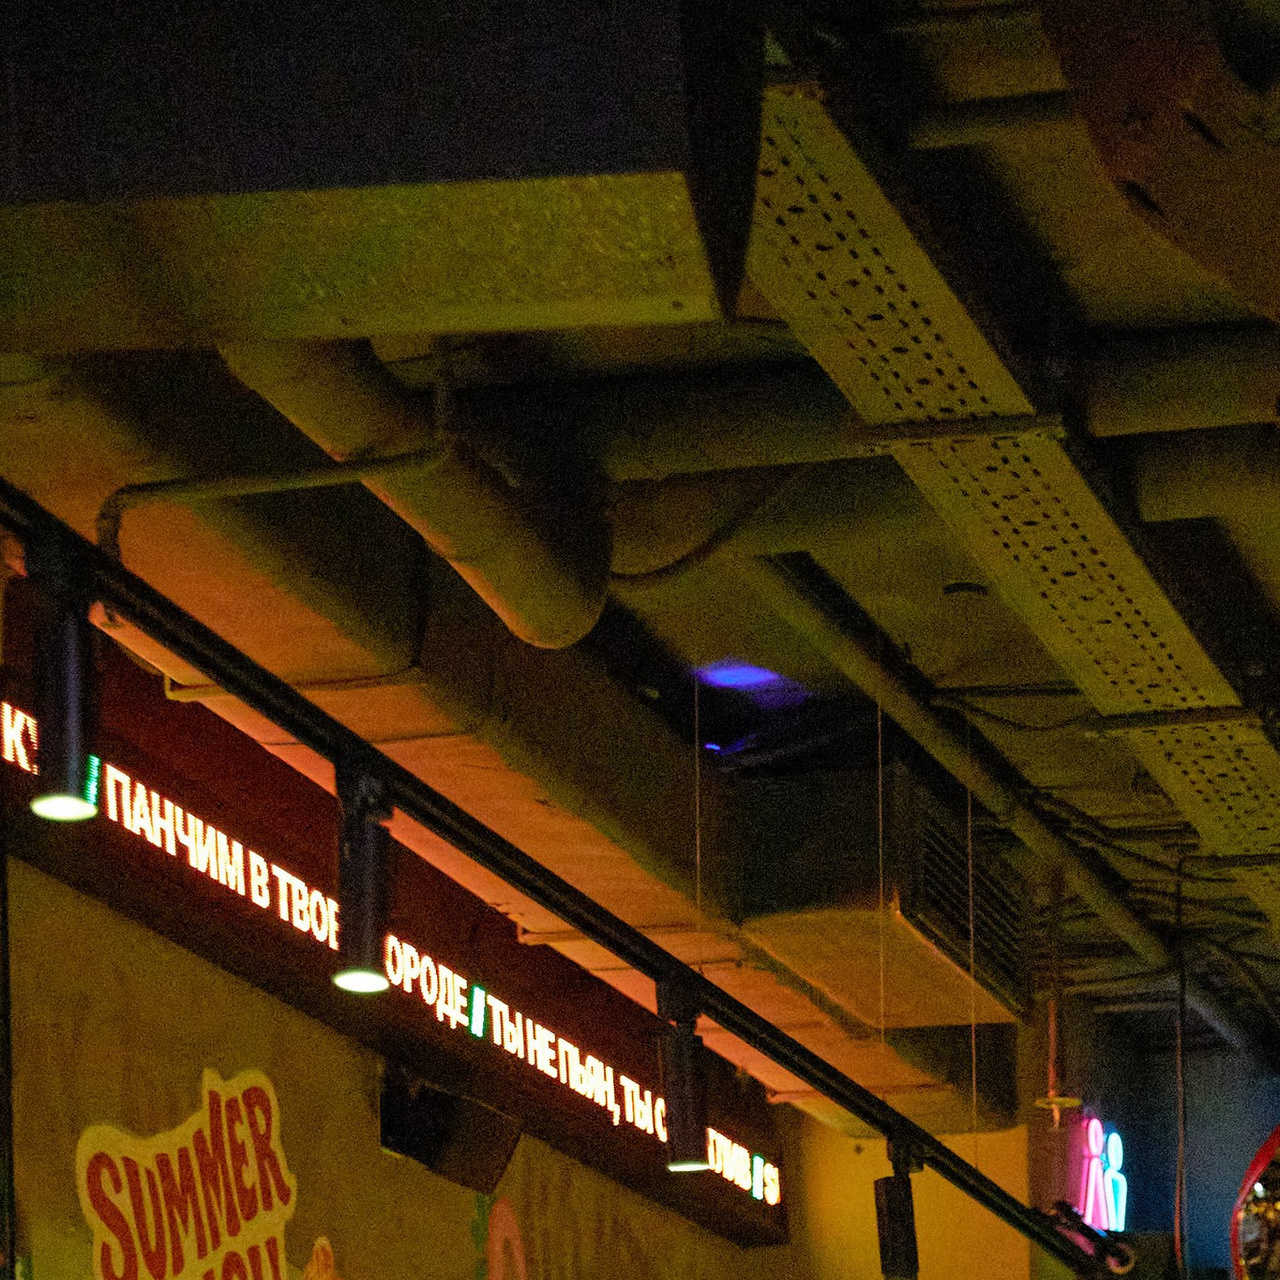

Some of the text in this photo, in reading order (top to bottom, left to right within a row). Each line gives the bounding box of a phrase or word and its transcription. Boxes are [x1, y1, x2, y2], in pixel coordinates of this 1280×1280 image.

[105, 763, 245, 896] ПАНЧИМ
[249, 850, 270, 909] В
[272, 864, 339, 951] ТВОЕ
[384, 934, 469, 1030] ОРОДЕ
[486, 994, 523, 1058] ТЫ
[525, 1018, 557, 1078] НЕ
[558, 1037, 620, 1126] ПЬЯН,
[620, 1075, 653, 1135] ТЫ
